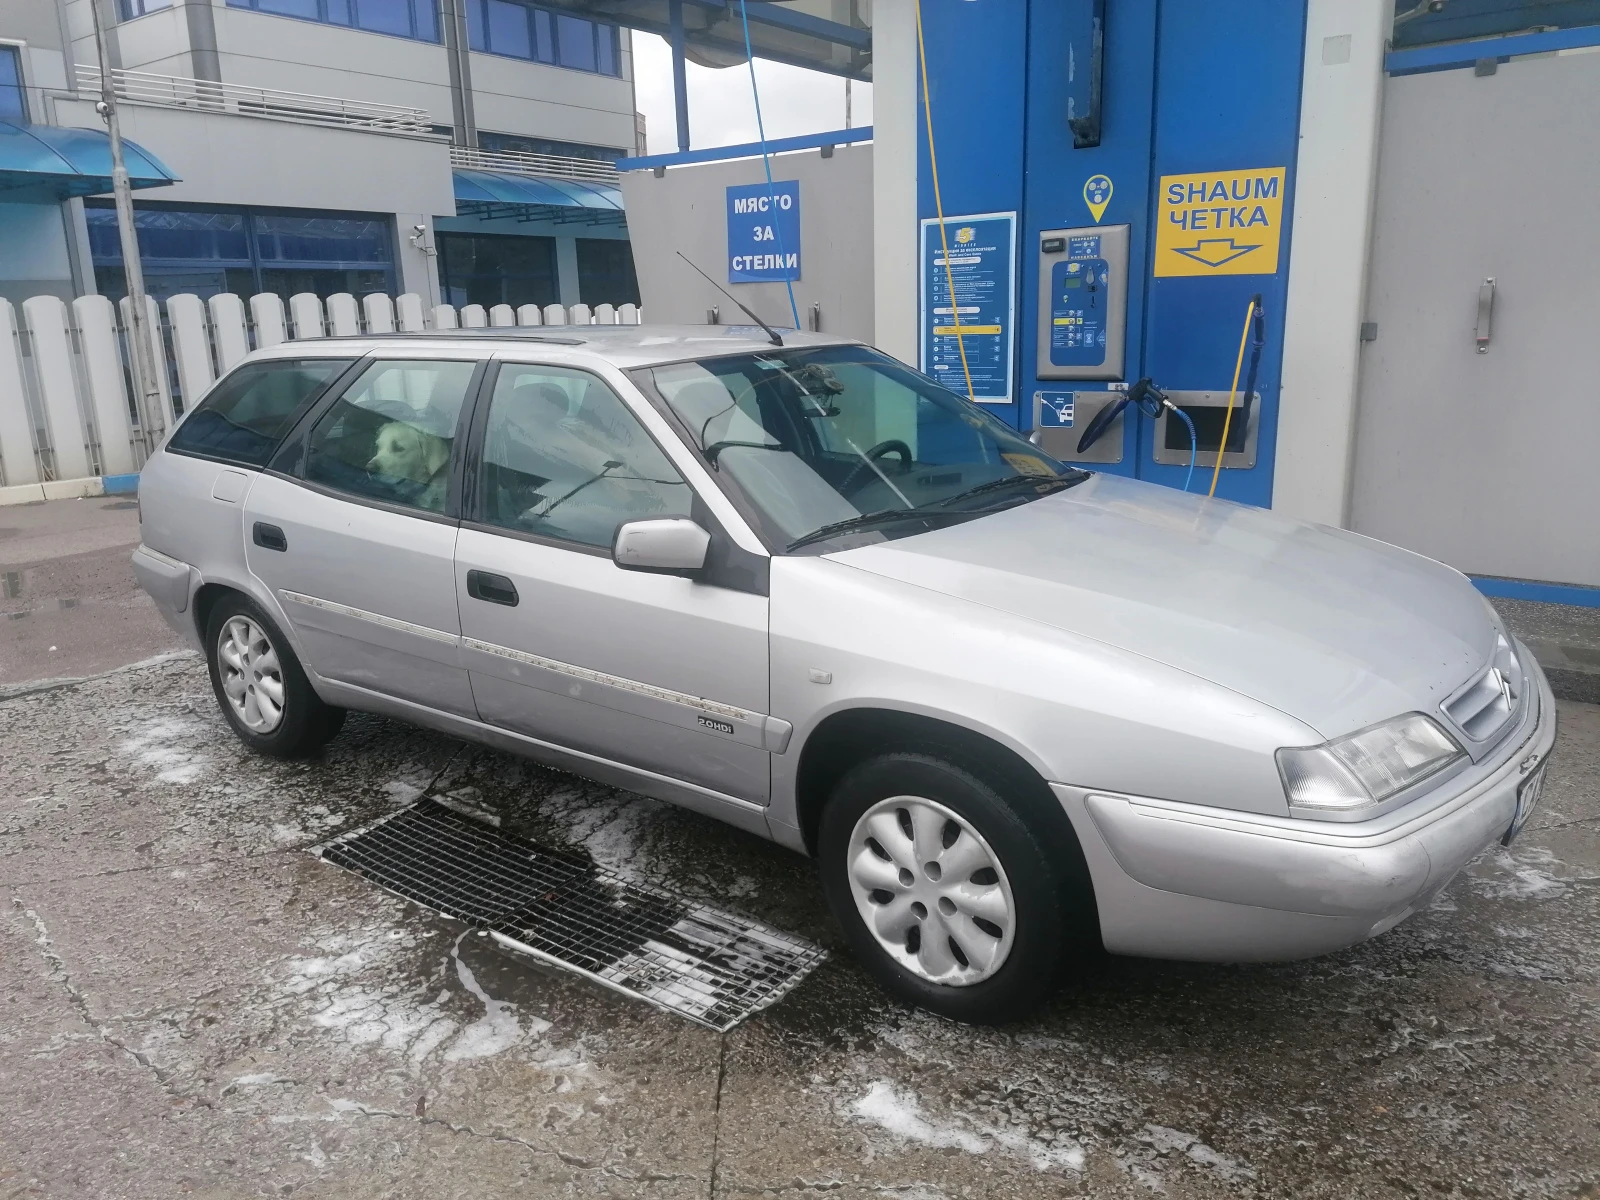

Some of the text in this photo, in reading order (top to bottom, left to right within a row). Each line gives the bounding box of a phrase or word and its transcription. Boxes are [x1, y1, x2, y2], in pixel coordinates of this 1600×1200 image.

[1167, 176, 1279, 205] SHAUM
[734, 194, 792, 214] МЯСТО
[1169, 205, 1270, 231] ЧЕТКА
[753, 225, 775, 241] ЗА
[959, 227, 971, 244] 5
[732, 253, 798, 271] СТЕЛКИ
